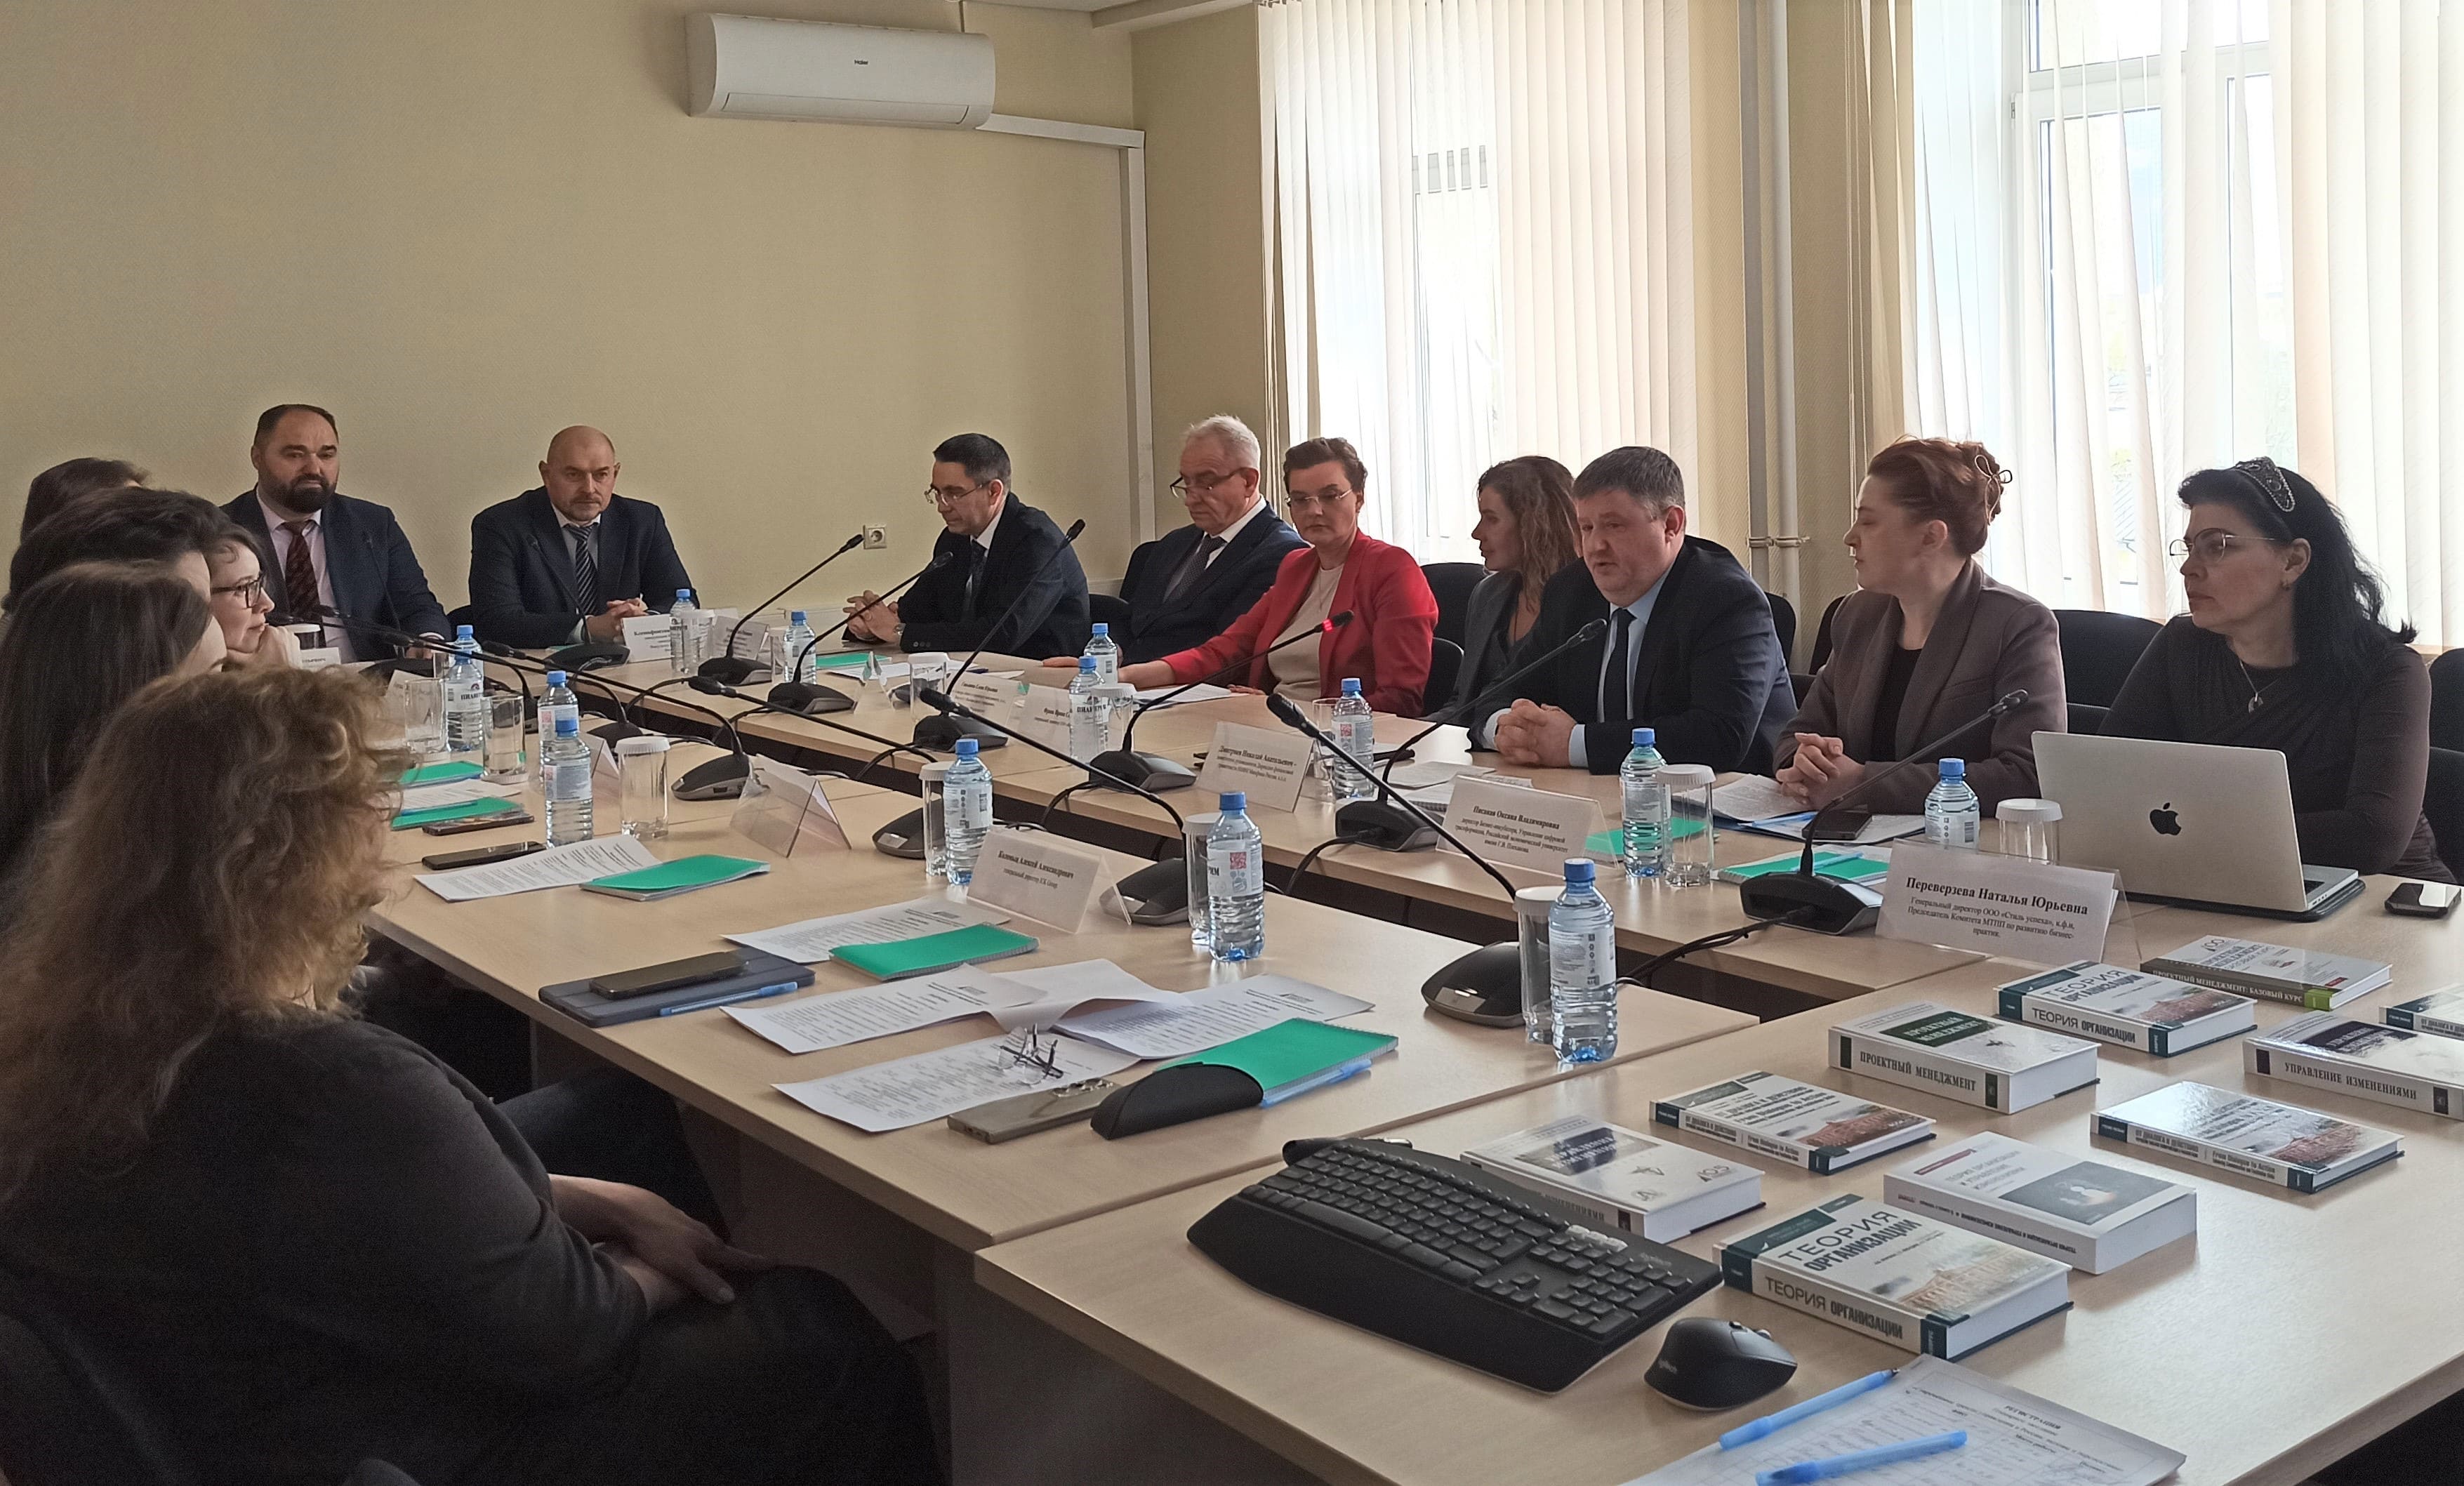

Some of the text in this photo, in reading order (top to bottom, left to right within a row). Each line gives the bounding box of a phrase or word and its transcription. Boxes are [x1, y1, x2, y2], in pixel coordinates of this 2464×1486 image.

[1906, 877, 2088, 915] Переверзева Наталья Юрьевна
[1911, 896, 1952, 909] Генеральный
[1952, 904, 1982, 915] директор
[1982, 908, 2000, 917] ООО
[1908, 905, 1949, 919] Председатель
[1951, 913, 1982, 924] Комитета
[2015, 924, 2048, 936] развитию
[2041, 969, 2126, 997] ТЕОРИЯ
[2152, 969, 2195, 983] ПРОЕКТНЫЙ
[2249, 987, 2283, 1000] БАЗОВЫЙ
[2284, 993, 2303, 1003] КУРС
[2032, 1007, 2135, 1043] ТЕОРИЯ ОРГАНИЗАЦИИ
[1860, 1052, 1976, 1092] ПРОЕКТНЫЙ МЕНЕДЖМЕНТ
[2285, 1062, 2416, 1100] УПРАВЛЕНИЕ ИЗМЕНЕНИЯМИ
[1778, 1211, 1898, 1261] ТЕОРИЯ
[1803, 1219, 1922, 1271] ОРГАНИЗАЦИИ
[1765, 1276, 1903, 1340] ТЕОРИЯ ОРГАНИЗАЦИИ
